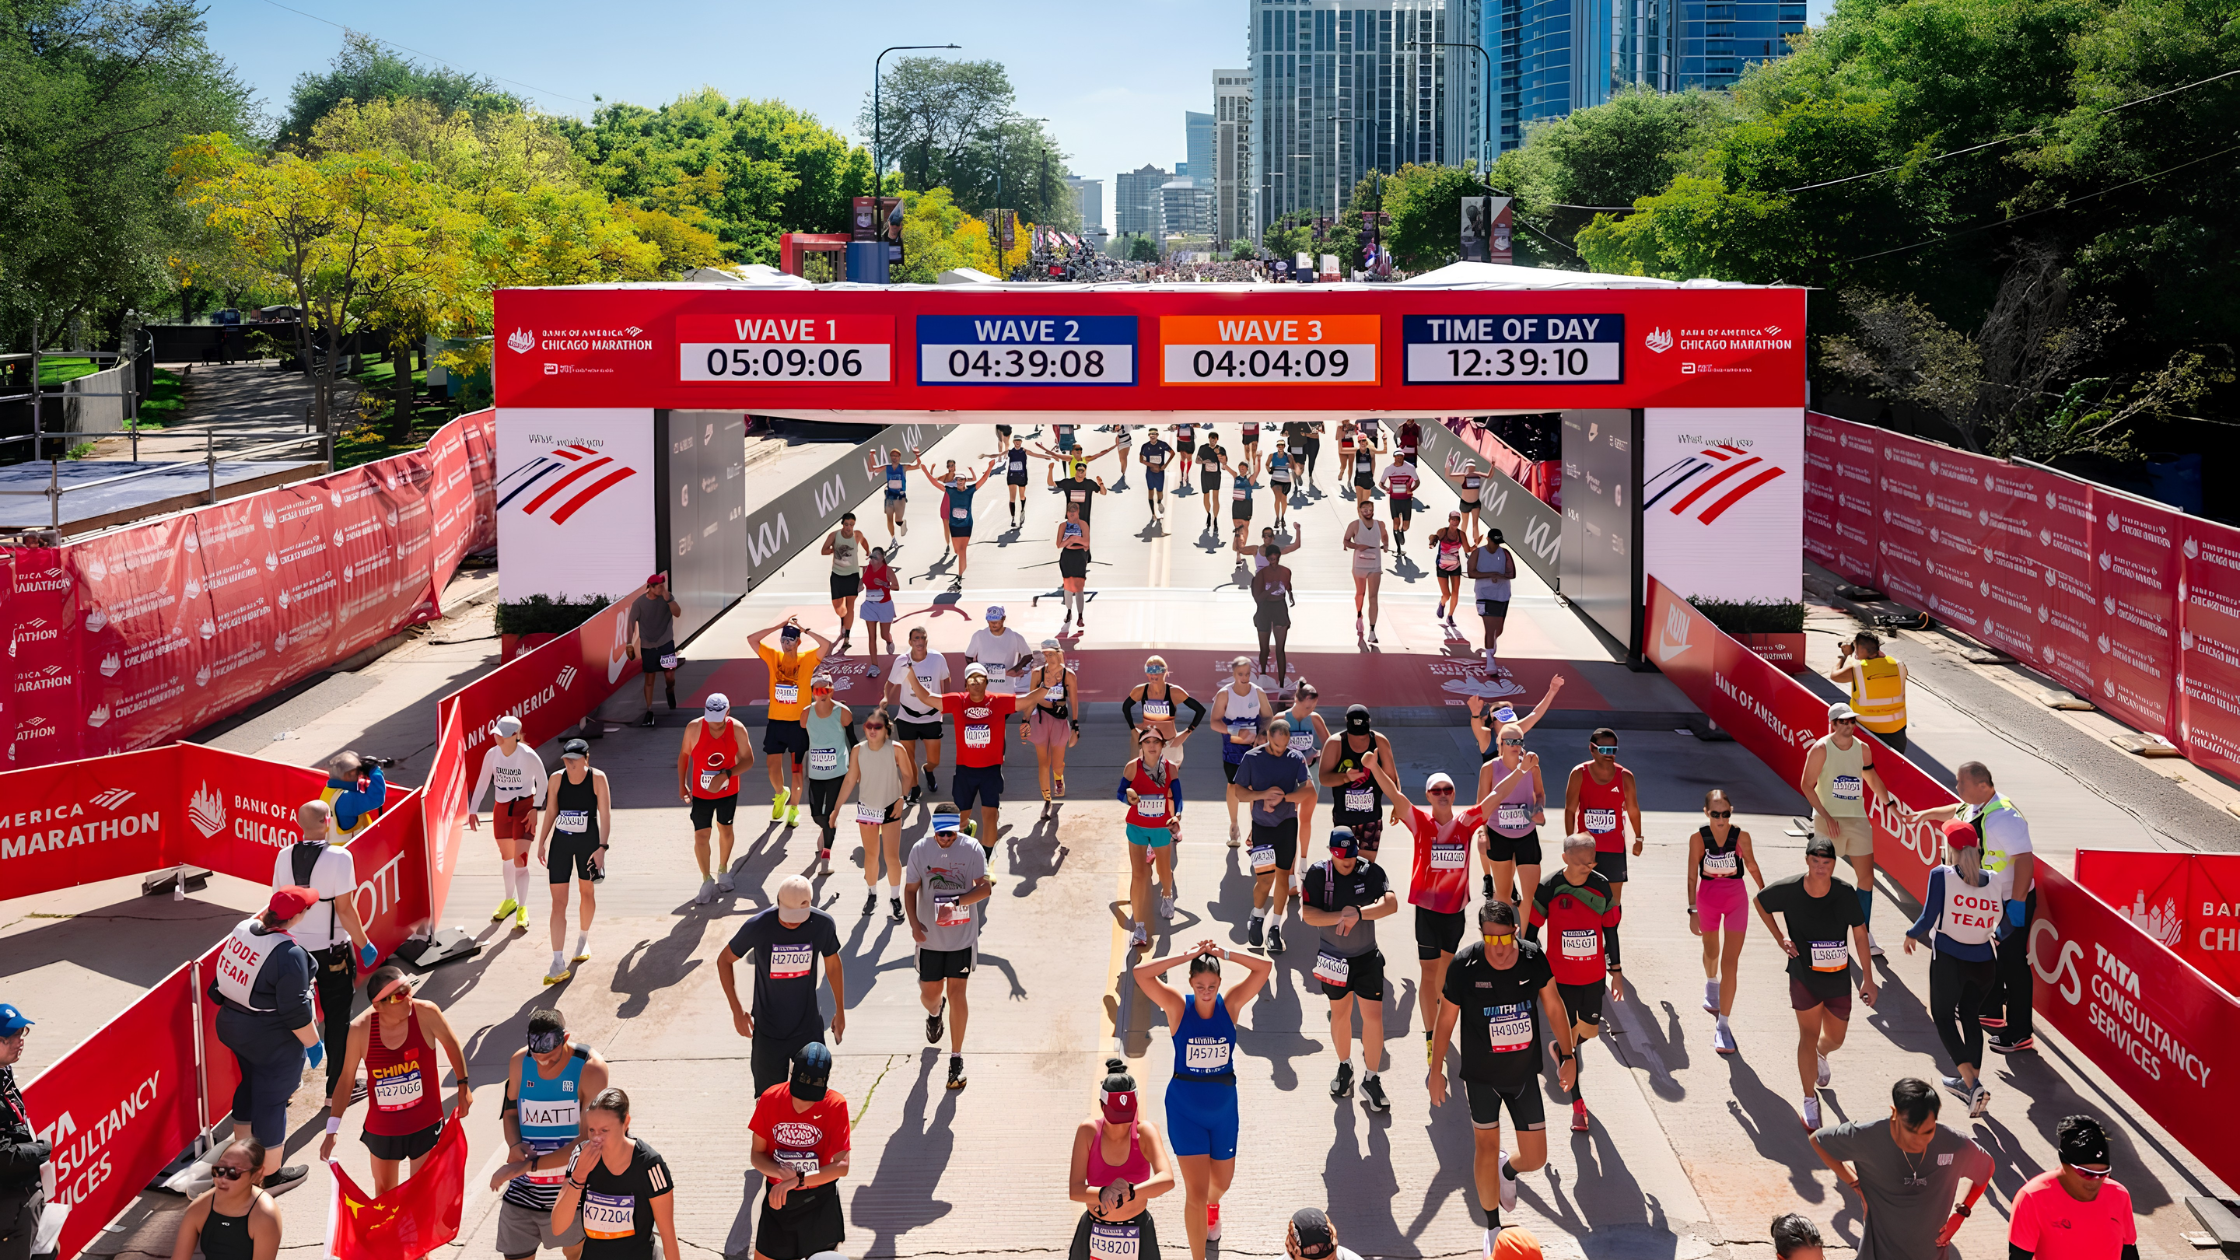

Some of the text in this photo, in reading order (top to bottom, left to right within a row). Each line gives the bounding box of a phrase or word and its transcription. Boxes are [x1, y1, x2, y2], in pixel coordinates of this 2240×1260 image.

[735, 319, 837, 341] WAVE 1
[974, 319, 1081, 342] WAVE 2
[1218, 320, 1323, 342] WAVE 3
[1427, 318, 1600, 341] TIME OF DAY
[542, 339, 653, 351] CHICAGO MARATHON
[1680, 339, 1793, 351] CHICAGO MARATHON
[707, 347, 863, 377] 05:09:06
[948, 349, 1105, 378] 04:39:08
[1193, 349, 1350, 378] 04:04:09
[1448, 348, 1588, 377] 12:39:10
[1739, 690, 1754, 710] OF
[234, 794, 268, 815] BANK
[271, 803, 287, 820] OF
[1, 811, 160, 860] MARATHON
[234, 817, 299, 849] CHICAGO
[1868, 788, 1948, 866] ABBOT
[353, 849, 406, 933] OTT
[1953, 893, 2000, 913] CODE
[229, 935, 261, 967] CODE
[2027, 917, 2084, 1006] CS
[219, 954, 249, 987] TEAM
[2094, 942, 2141, 1001] TATA
[2088, 1002, 2161, 1081] SERVICES
[2091, 973, 2211, 1089] CONSULTANCY
[372, 1060, 420, 1079] CHINA
[36, 1110, 78, 1148] TA
[51, 1069, 161, 1184] SULTANCY
[523, 1106, 576, 1125] MATT
